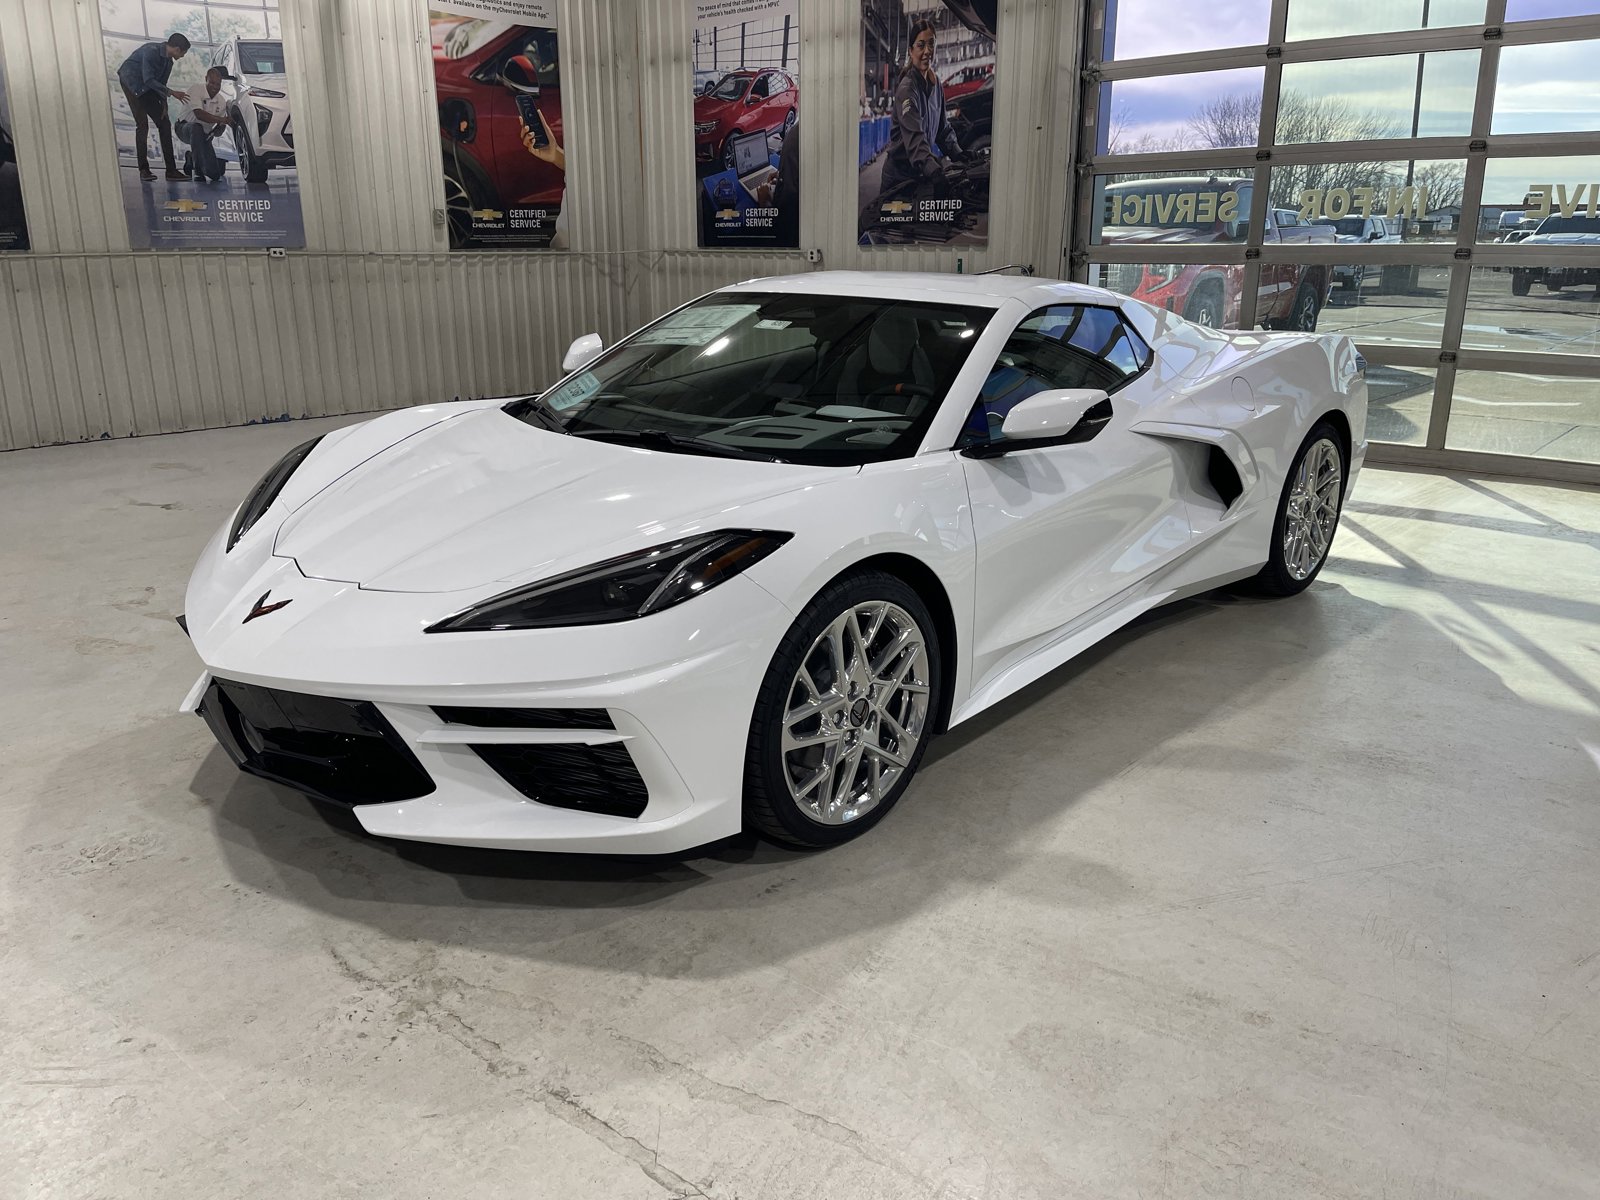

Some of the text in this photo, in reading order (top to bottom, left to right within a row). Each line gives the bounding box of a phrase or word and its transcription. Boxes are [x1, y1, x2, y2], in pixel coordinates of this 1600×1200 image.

[705, 4, 716, 12] peace
[737, 5, 753, 13] checked
[217, 199, 271, 211] CERTIFIED
[919, 199, 962, 210] CERTIFIED
[509, 209, 547, 218] CERTIFIED
[745, 207, 779, 217] CERTIFIED
[919, 211, 955, 222] SERVICE
[219, 211, 264, 223] SERVICE
[510, 219, 541, 228] SERVICE
[745, 218, 773, 227] SERVICE
